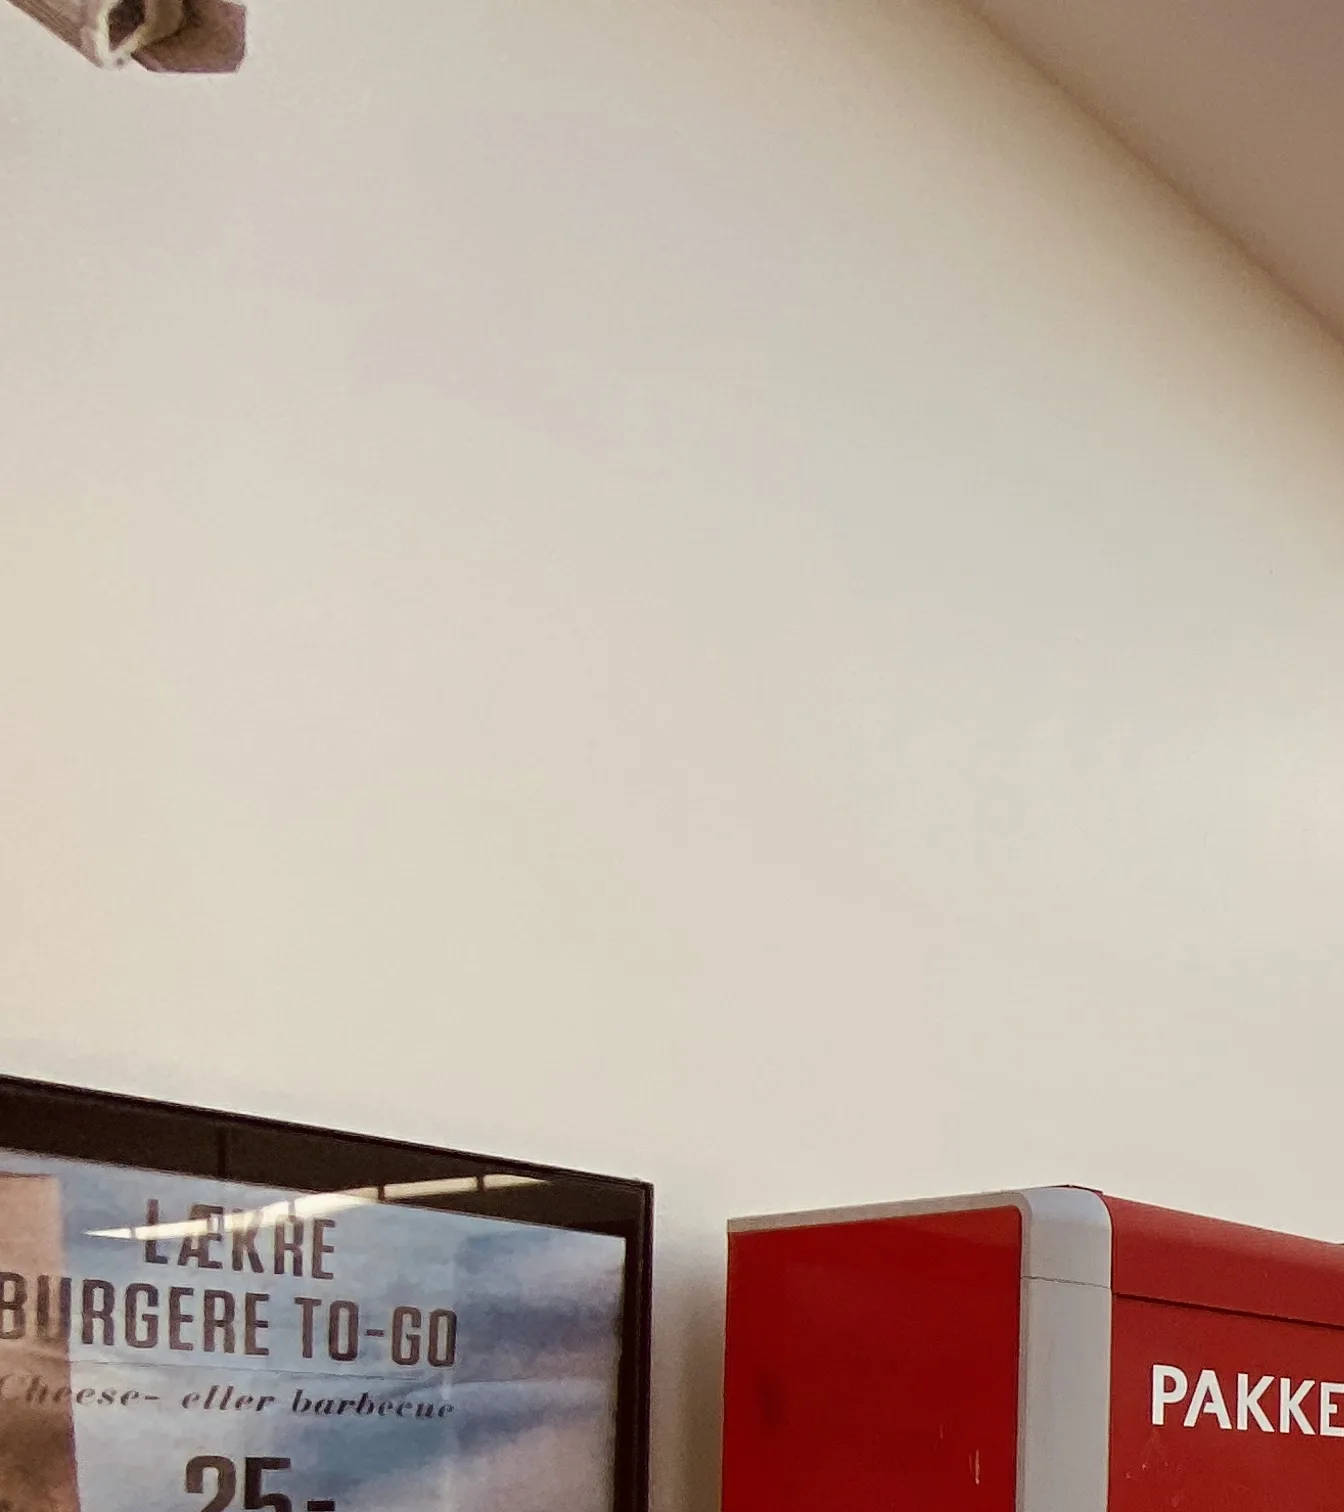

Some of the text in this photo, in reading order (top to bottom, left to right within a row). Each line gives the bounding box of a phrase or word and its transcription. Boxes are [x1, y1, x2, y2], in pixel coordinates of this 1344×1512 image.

[143, 1199, 336, 1280] LÆKRE
[0, 1272, 458, 1368] BURGERE TO-GO
[181, 1384, 275, 1413] eller
[291, 1388, 456, 1420] barbecue
